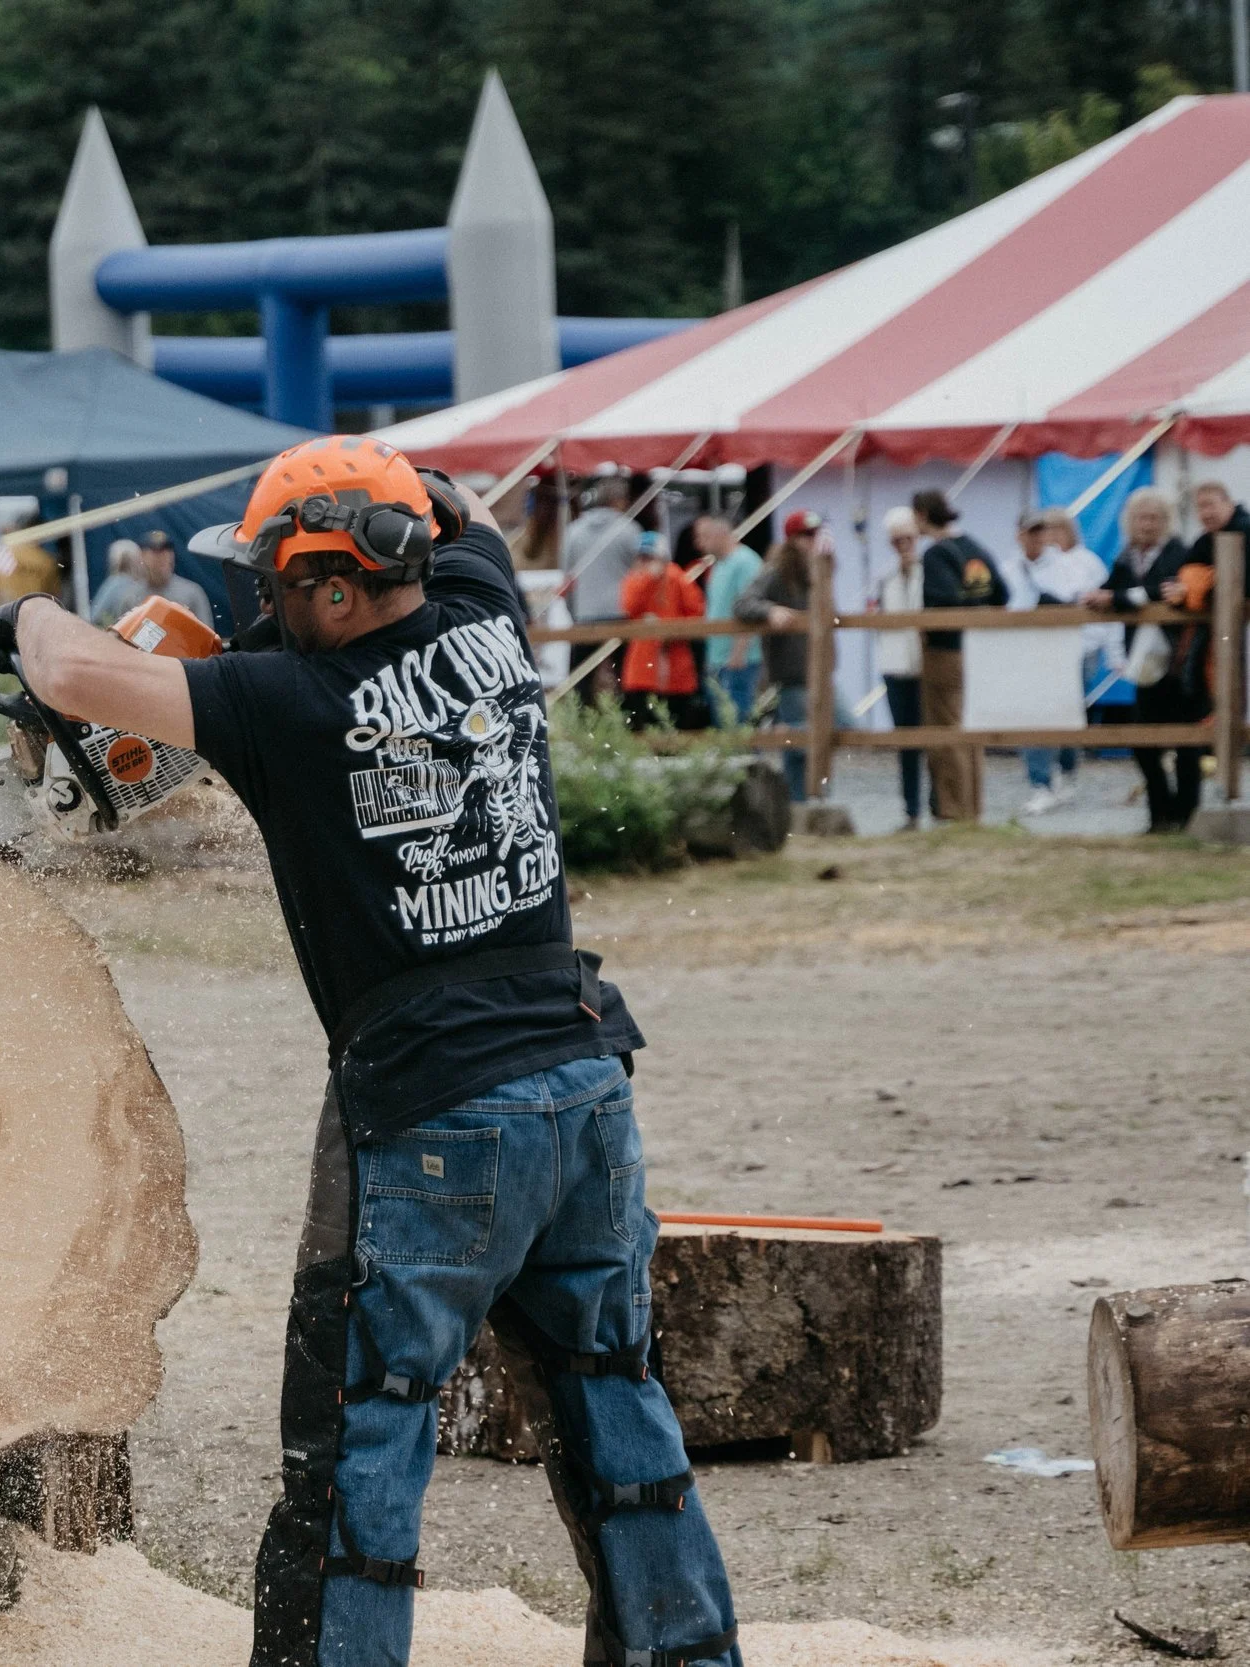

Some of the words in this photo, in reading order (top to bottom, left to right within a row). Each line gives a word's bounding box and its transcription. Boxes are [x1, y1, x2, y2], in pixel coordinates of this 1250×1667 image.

[112, 745, 146, 768] STIHL
[116, 762, 131, 773] MS
[399, 833, 455, 872] Troll
[449, 842, 488, 867] MMXVII
[395, 865, 512, 930] MINING
[518, 830, 560, 896] CLUB
[412, 858, 446, 883] Co.
[422, 932, 440, 945] BY
[444, 927, 469, 943] ANY
[469, 914, 506, 937] MEAN
